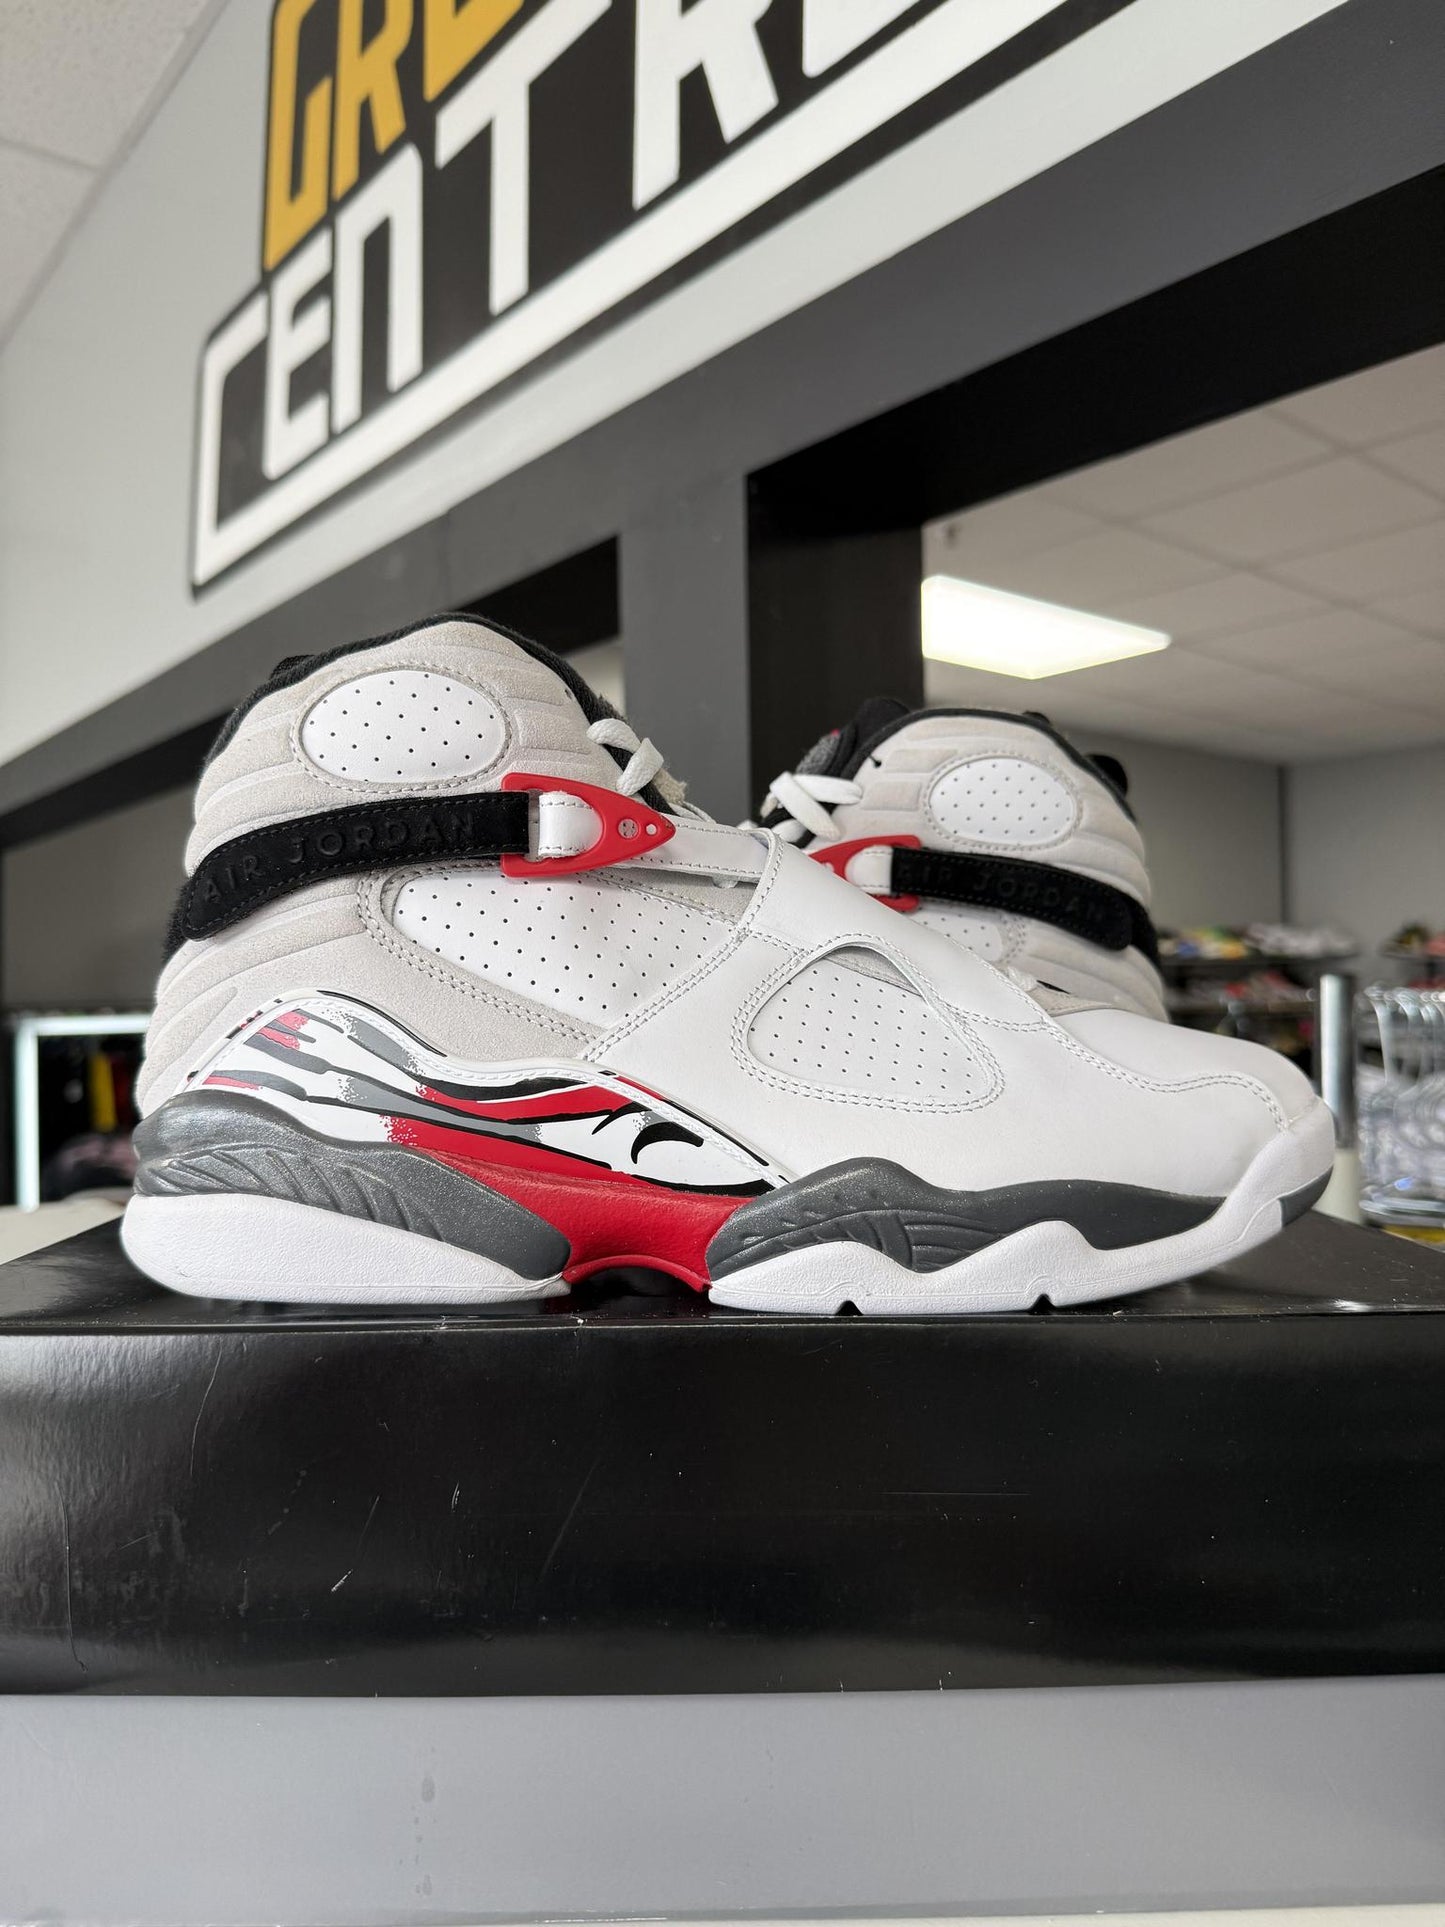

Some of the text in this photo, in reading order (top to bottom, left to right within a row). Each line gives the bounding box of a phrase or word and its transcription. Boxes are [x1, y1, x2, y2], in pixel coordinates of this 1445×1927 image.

[204, 812, 475, 904] AIR JORDAN
[972, 872, 1106, 921] JORDAN
